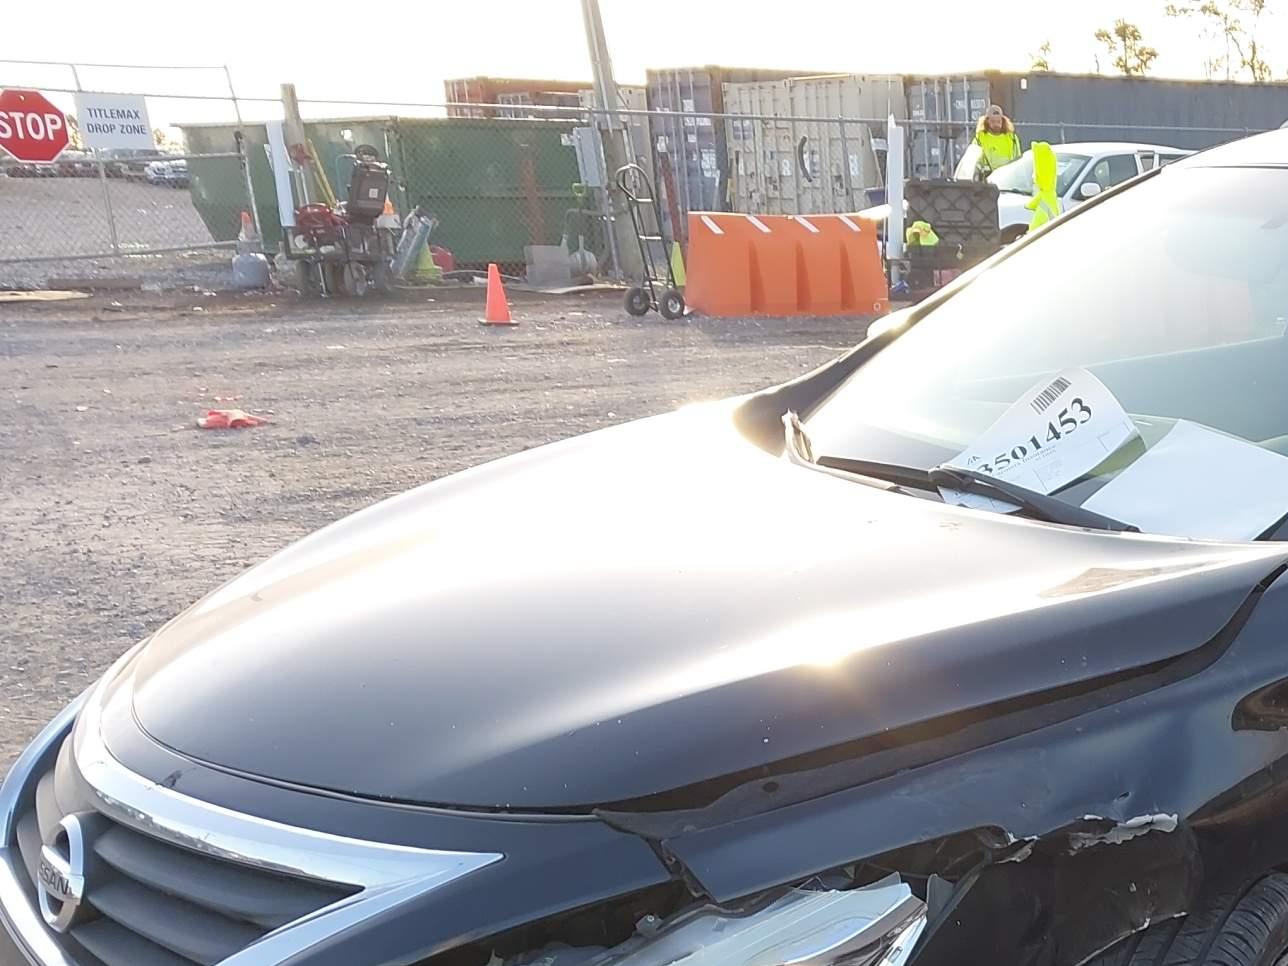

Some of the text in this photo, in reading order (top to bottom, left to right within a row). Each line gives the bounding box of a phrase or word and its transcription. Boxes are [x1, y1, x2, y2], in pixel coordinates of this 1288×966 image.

[86, 107, 140, 120] TITLEMAX
[0, 111, 62, 140] STOP
[86, 123, 147, 135] DROP ZONE
[976, 397, 1092, 473] 3501453
